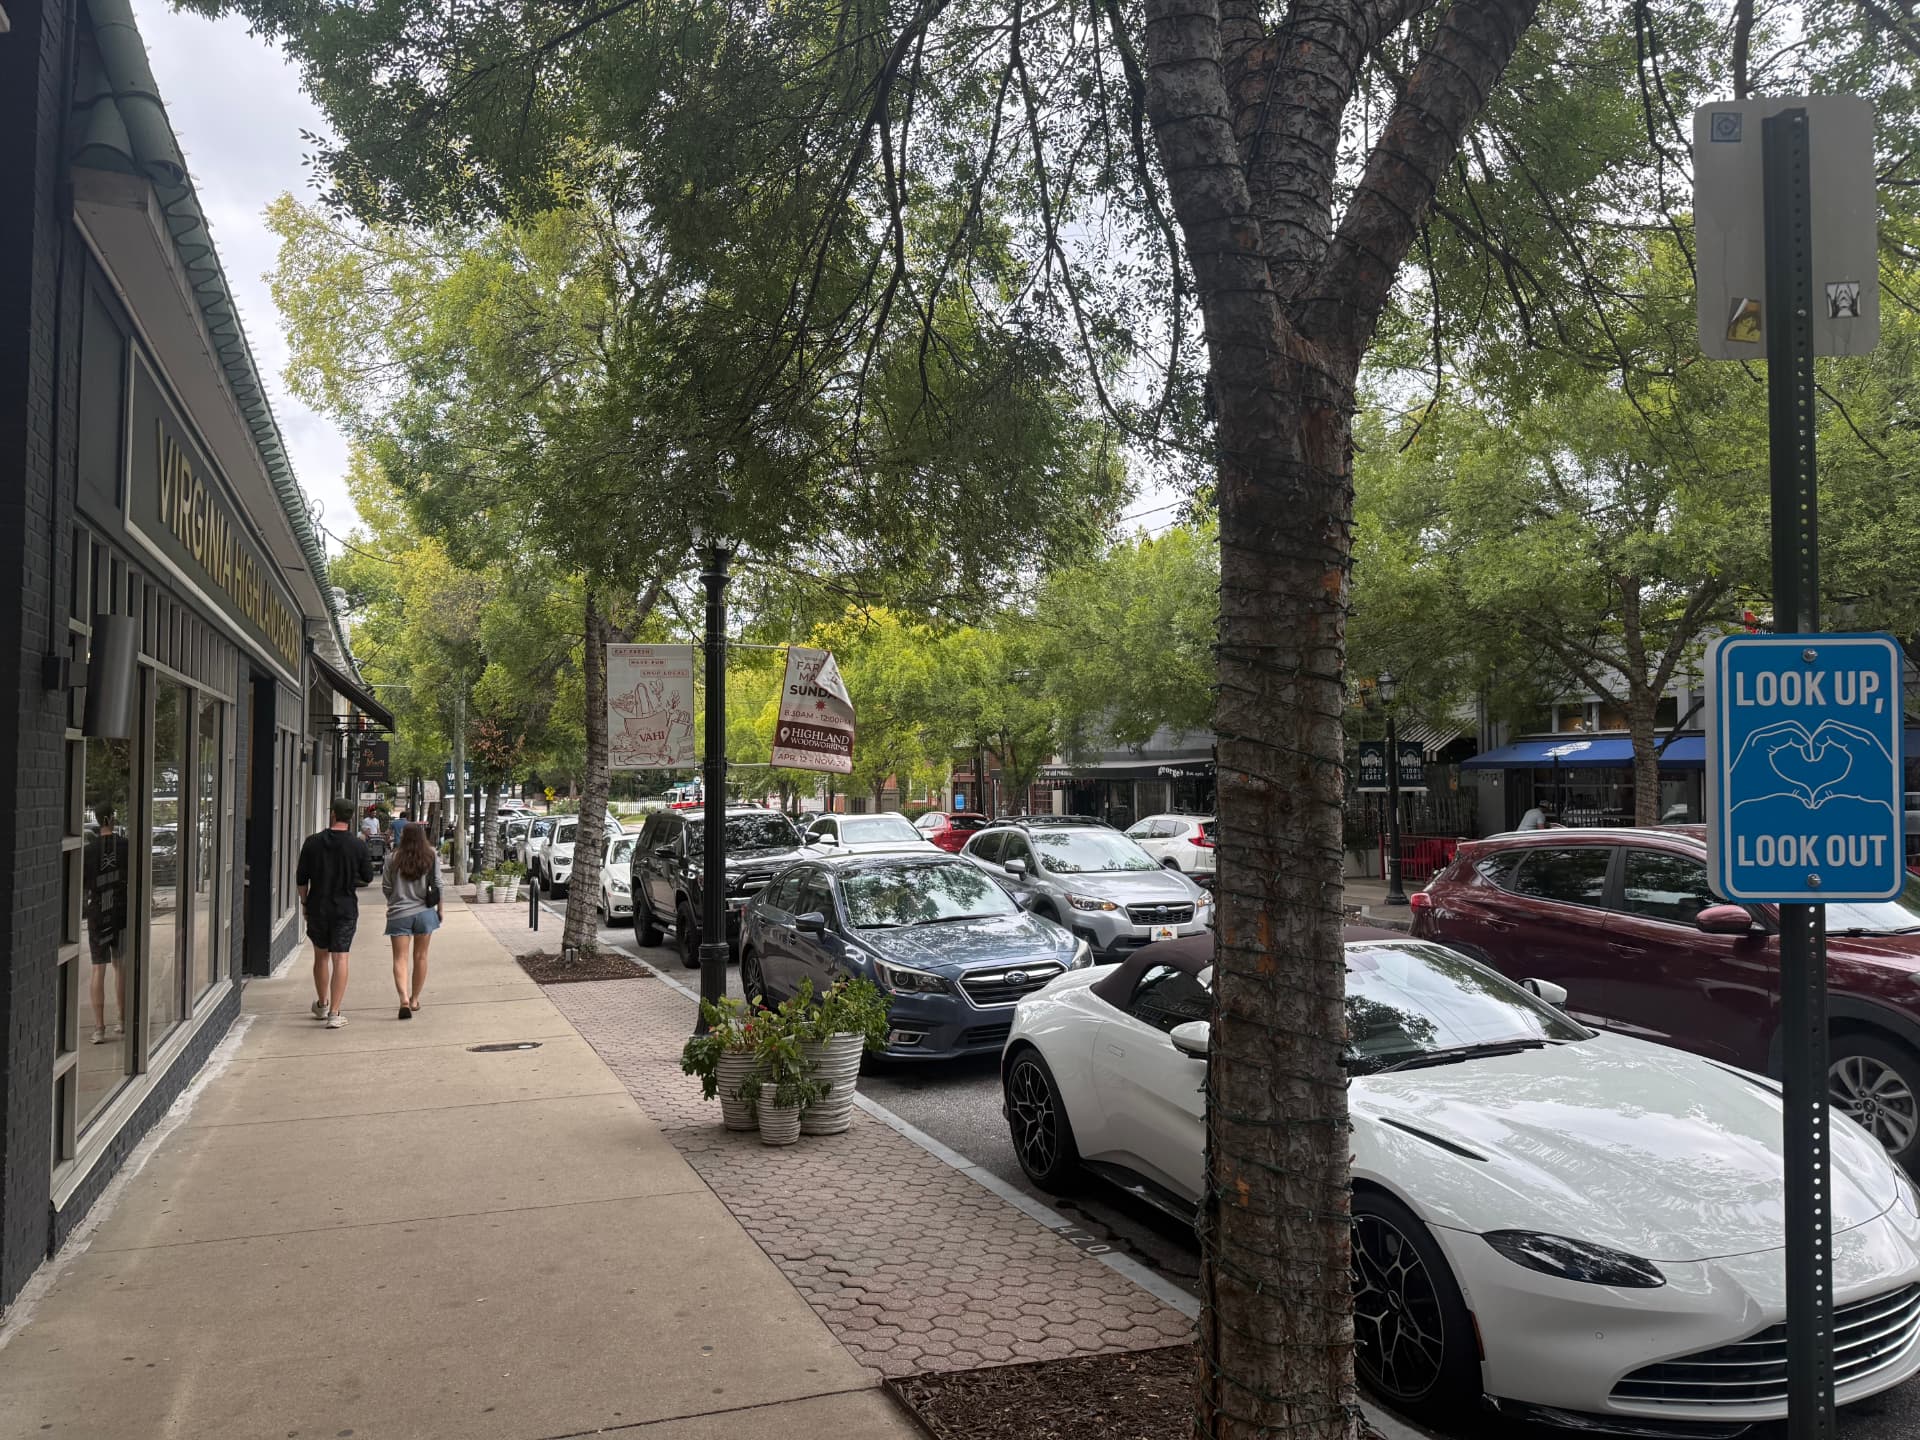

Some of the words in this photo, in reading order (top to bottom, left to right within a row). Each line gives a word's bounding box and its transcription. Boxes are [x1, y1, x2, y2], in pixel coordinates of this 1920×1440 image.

[156, 416, 232, 596] VIRGINIA
[233, 535, 279, 646] HIGHLAND
[279, 604, 299, 672] BOOKS
[1736, 671, 1826, 706] LOOK
[1834, 670, 1883, 714] UP,
[639, 730, 665, 742] VAHI
[790, 736, 848, 752] WOODWORKING
[791, 727, 850, 745] HIGHLAND
[1738, 834, 1820, 867] LOOK
[1826, 834, 1887, 867] OUT
[1059, 1226, 1112, 1253] 420
